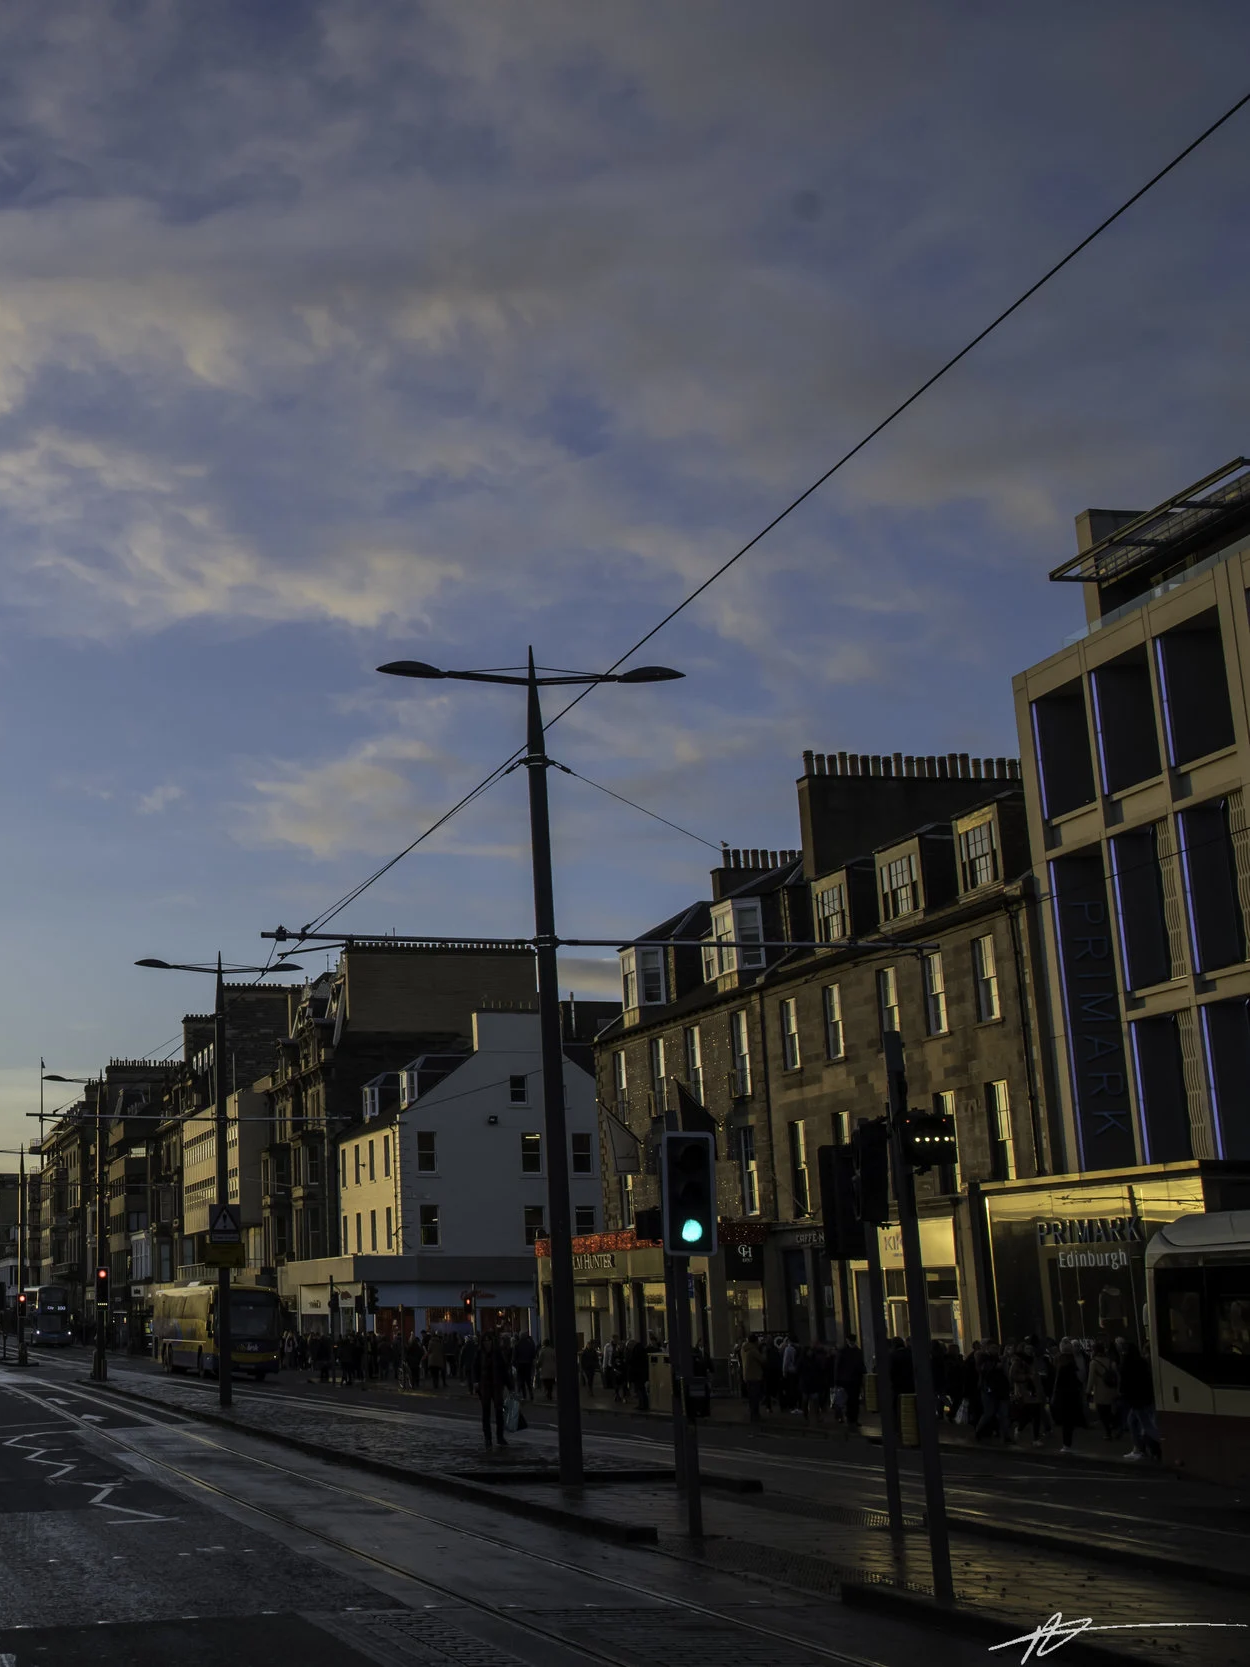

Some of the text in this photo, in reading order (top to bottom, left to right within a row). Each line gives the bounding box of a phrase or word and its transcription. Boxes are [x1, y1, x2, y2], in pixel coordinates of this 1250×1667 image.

[1070, 901, 1129, 1134] PRIMARK
[1037, 1217, 1141, 1246] PRIMARK
[584, 1253, 613, 1269] HUNTER
[1058, 1249, 1128, 1270] Edinburgh
